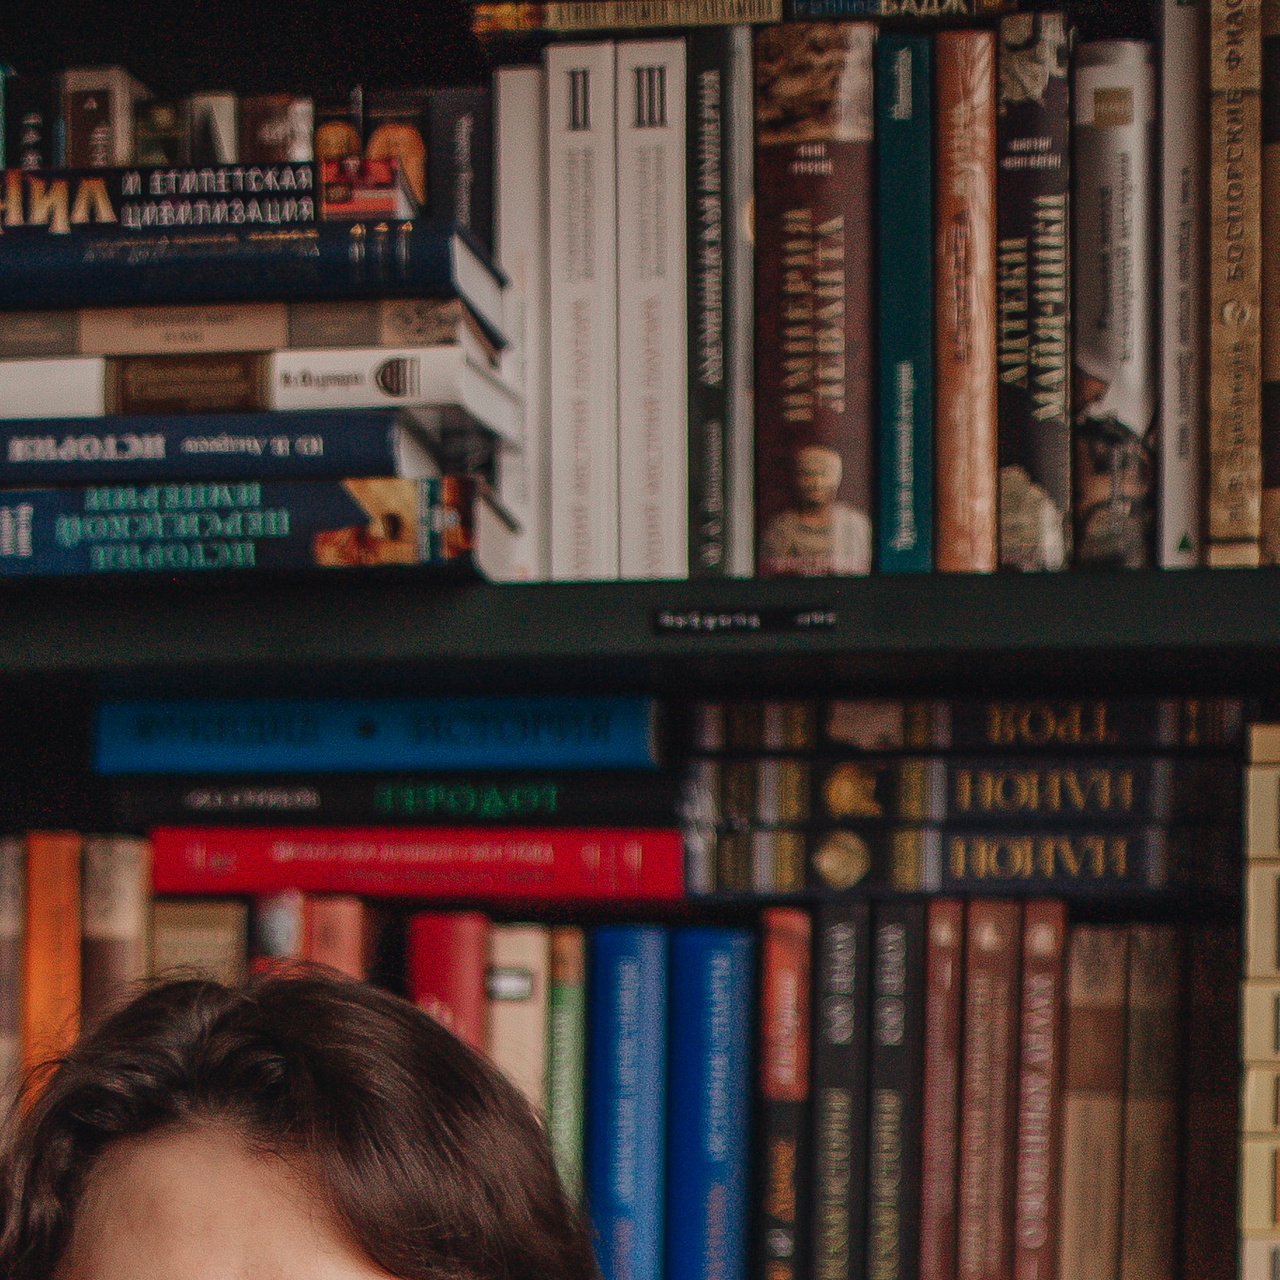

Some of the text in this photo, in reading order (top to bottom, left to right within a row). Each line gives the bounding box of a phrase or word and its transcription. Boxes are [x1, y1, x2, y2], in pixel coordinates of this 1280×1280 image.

[148, 165, 315, 194] ЕГИПЕТСКАЯ
[121, 196, 315, 231] ЦИВИЛИЗАЦИЯ
[373, 782, 559, 818] ГЕРОДОТ
